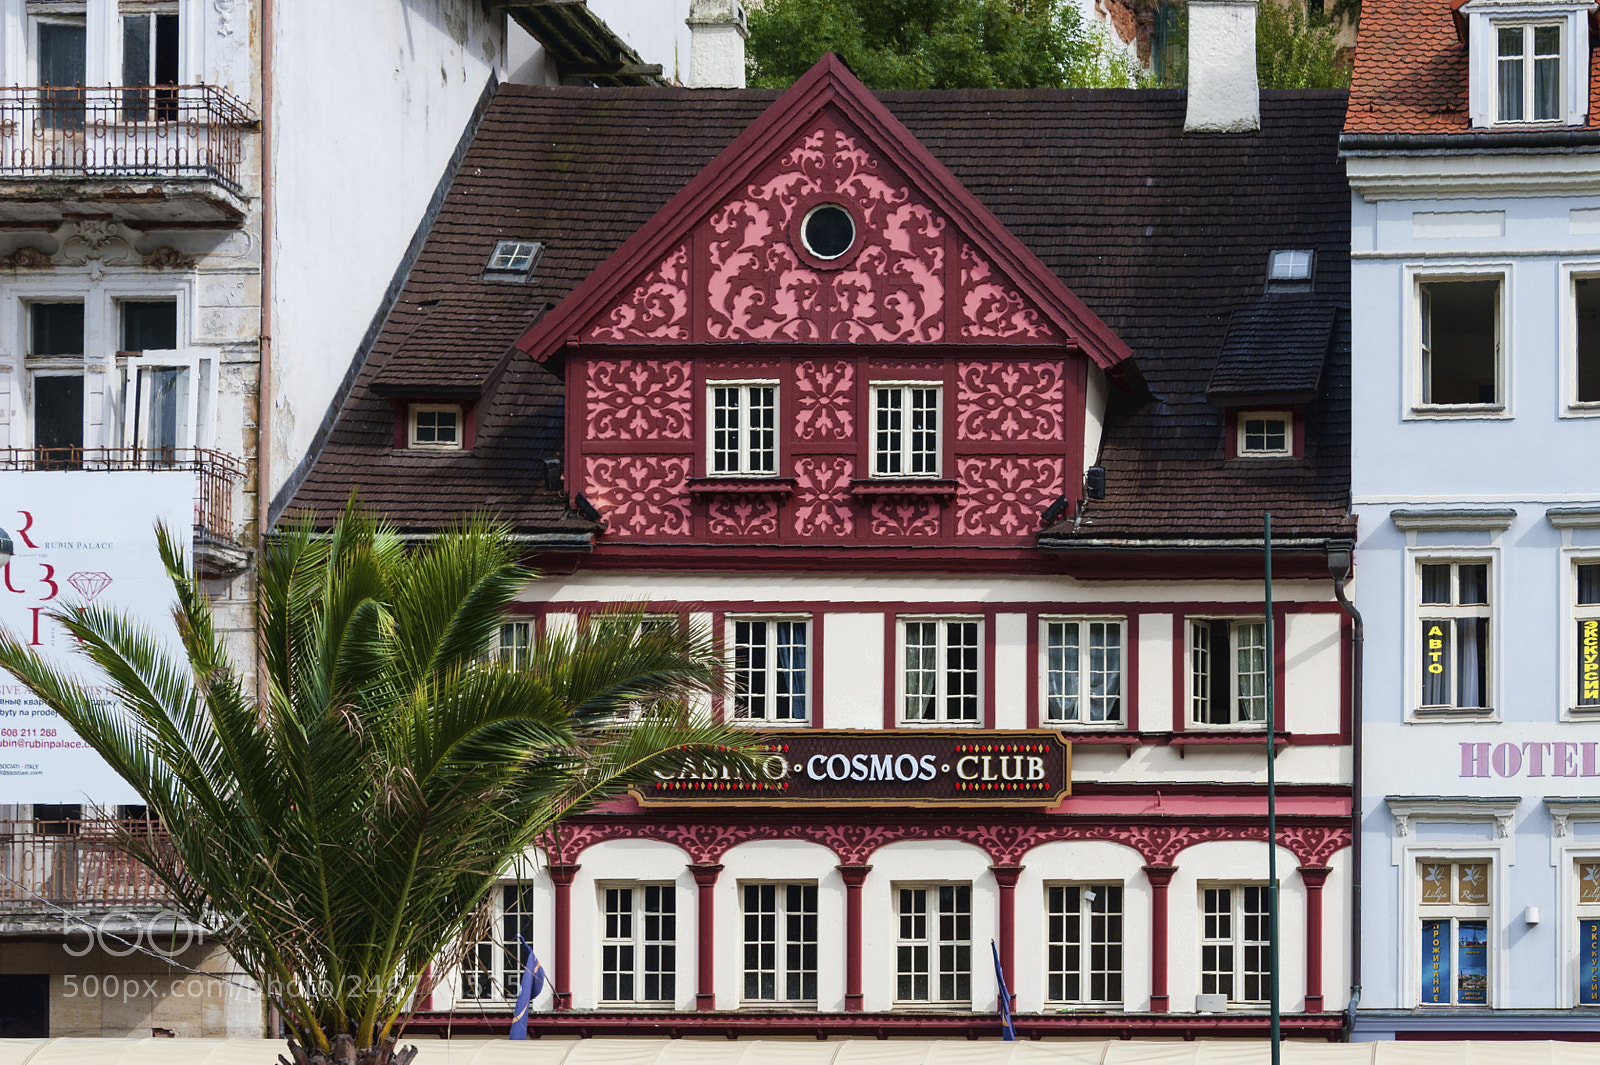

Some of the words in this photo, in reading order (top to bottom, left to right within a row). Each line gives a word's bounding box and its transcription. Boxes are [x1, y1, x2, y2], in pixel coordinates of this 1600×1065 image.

[45, 541, 74, 549] RUBIN
[77, 541, 114, 550] PALACE
[1428, 626, 1443, 674] АВТО
[1584, 620, 1599, 699] ЭКСКУРСИИ
[0, 685, 20, 695] IVE
[1, 728, 18, 737] 608
[20, 728, 37, 737] 211
[40, 728, 57, 737] 288
[0, 739, 94, 749] bin@rubinpalace.c
[807, 754, 938, 782] COSMOS
[956, 755, 1046, 781] CLUB
[1458, 742, 1600, 778] HOTEL
